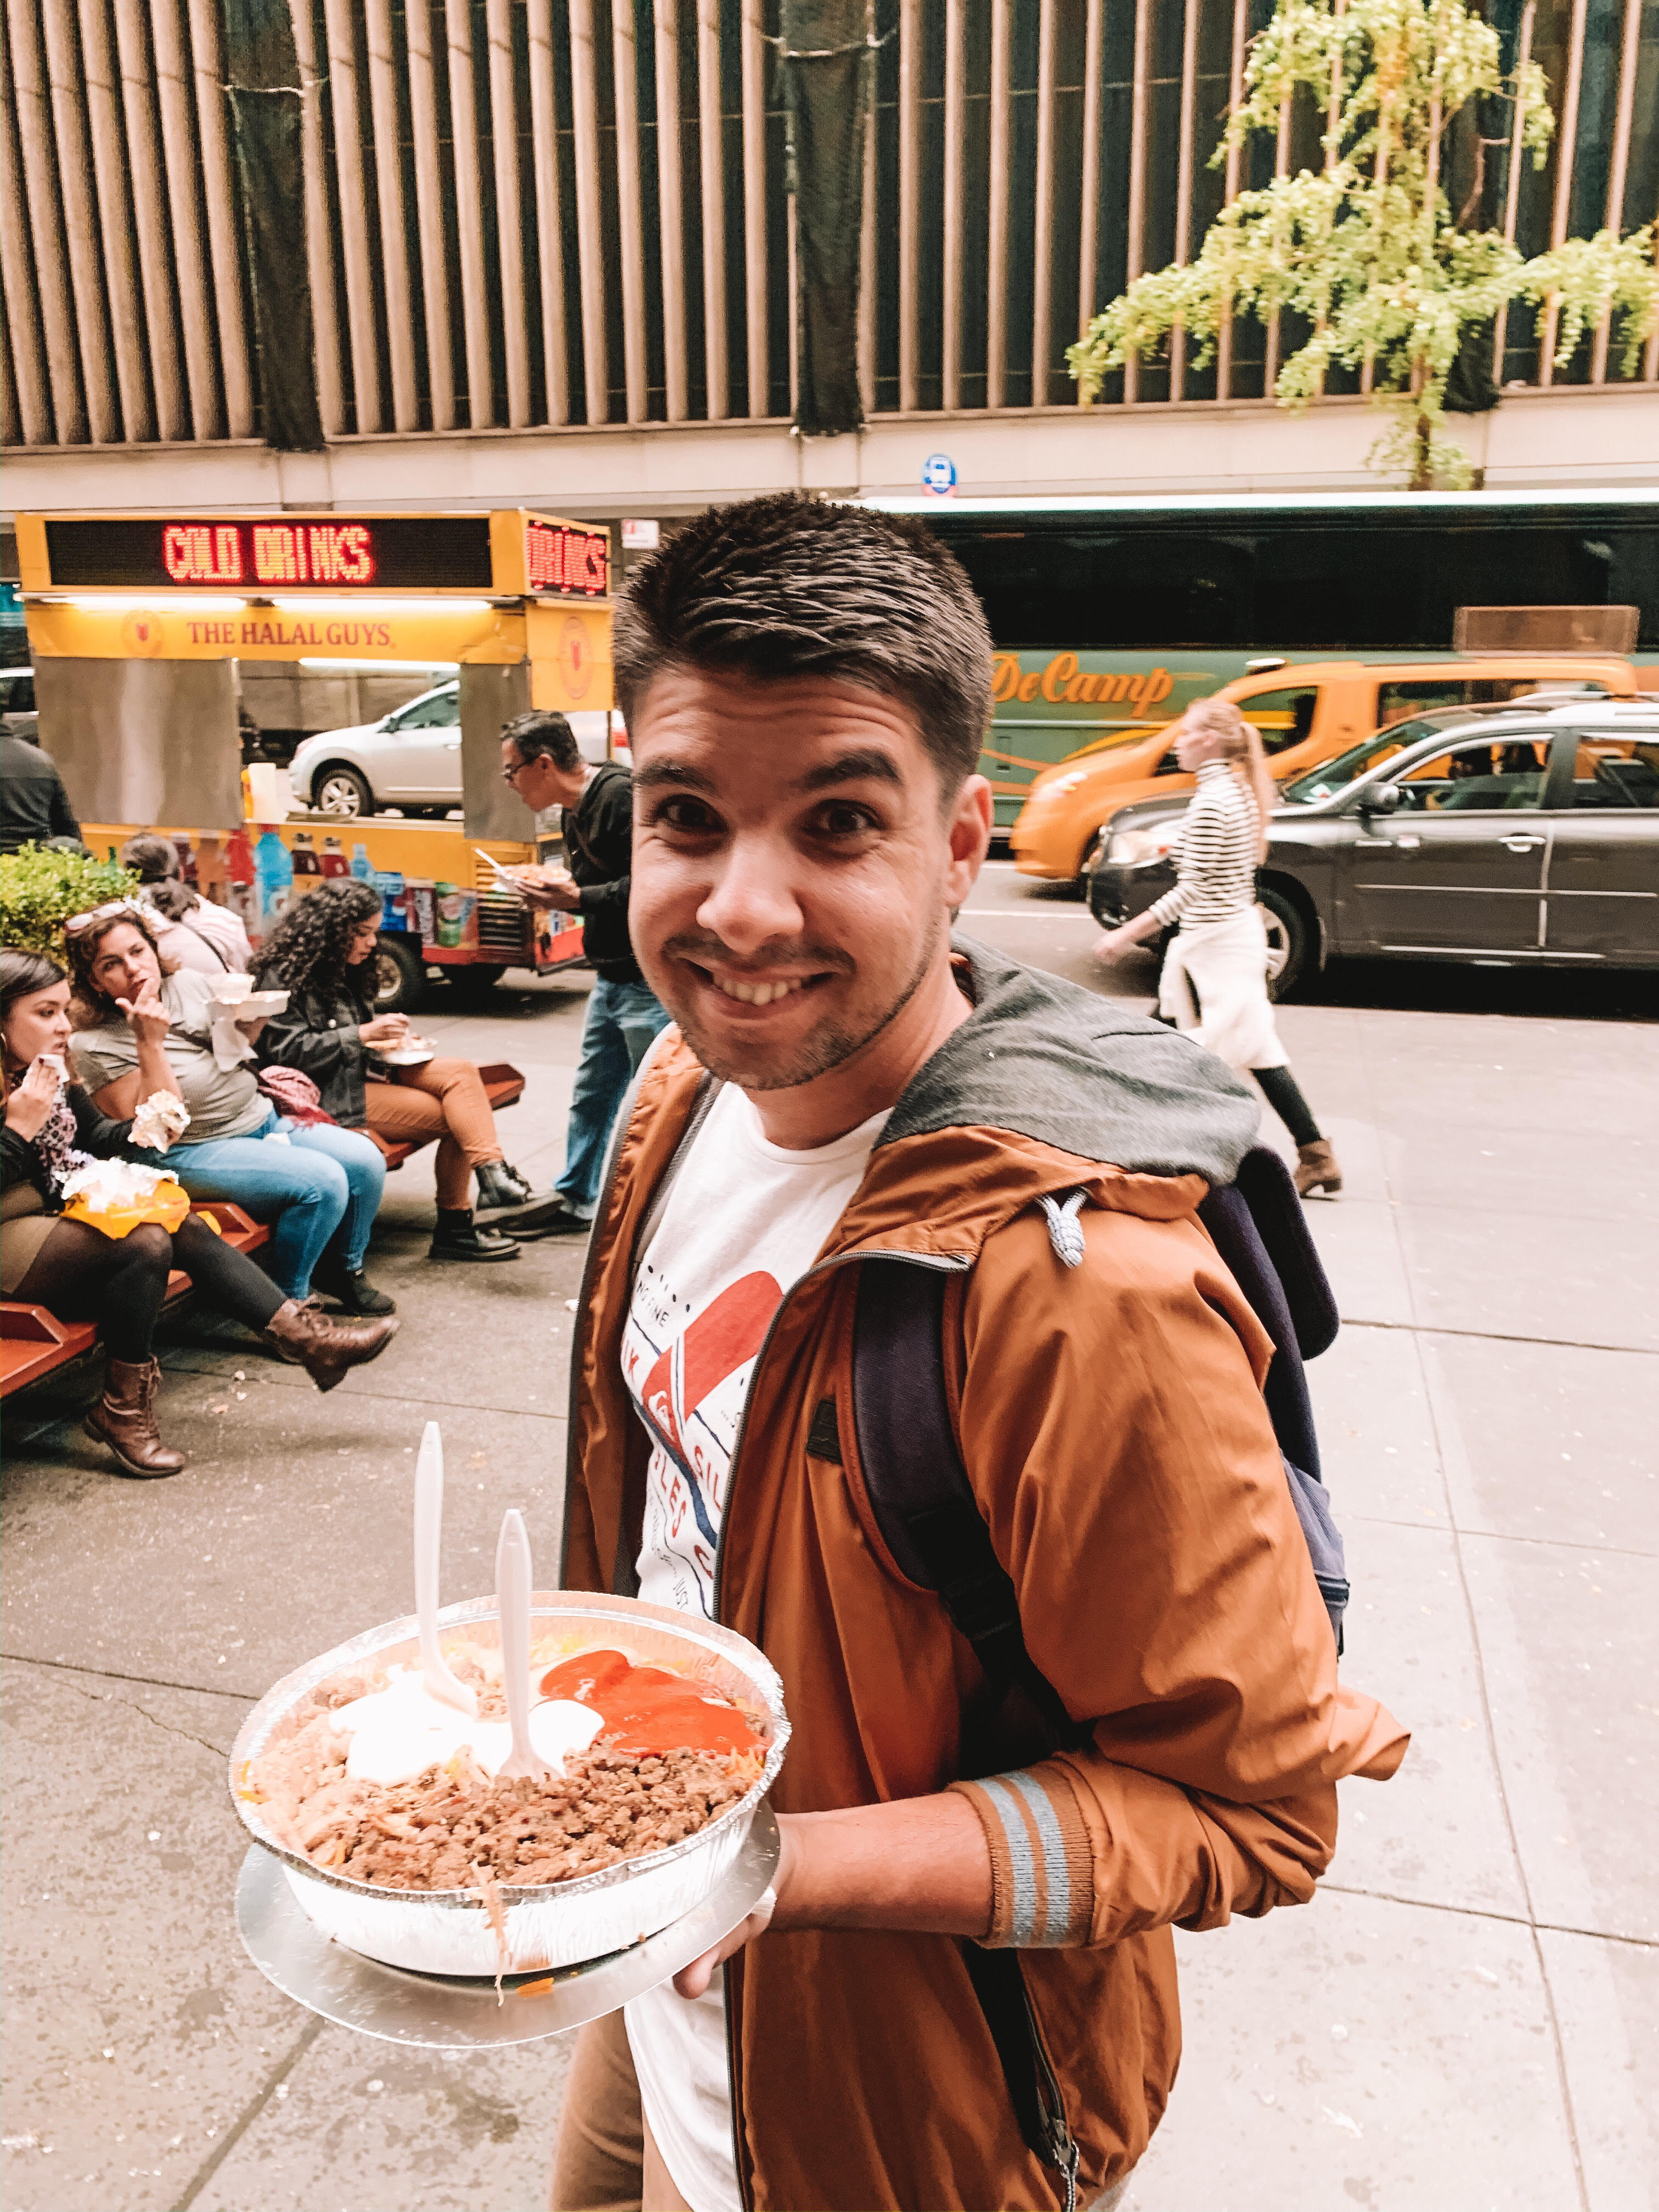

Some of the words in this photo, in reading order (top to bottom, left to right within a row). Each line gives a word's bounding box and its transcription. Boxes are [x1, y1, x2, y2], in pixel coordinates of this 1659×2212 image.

[253, 525, 373, 582] DRINKS
[187, 622, 235, 644] THE
[241, 622, 323, 645] HALAL
[990, 651, 1175, 719] DeCamp
